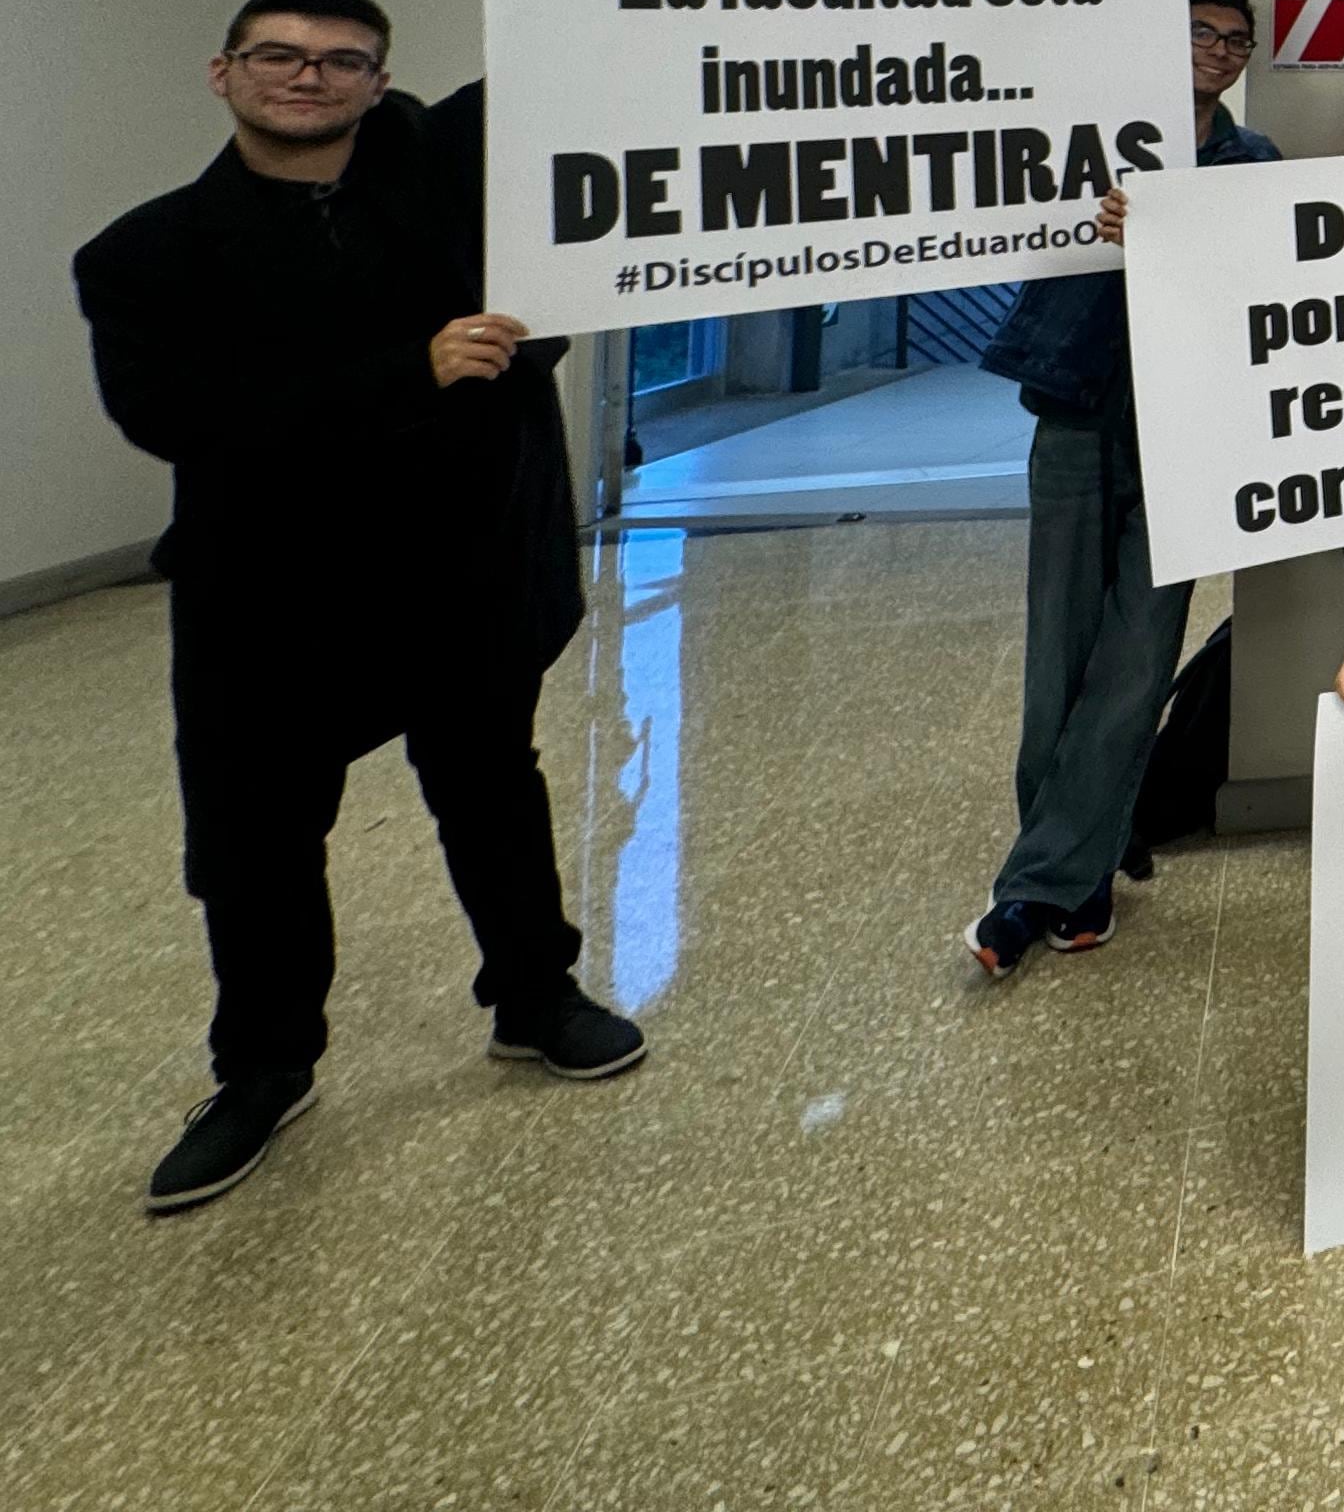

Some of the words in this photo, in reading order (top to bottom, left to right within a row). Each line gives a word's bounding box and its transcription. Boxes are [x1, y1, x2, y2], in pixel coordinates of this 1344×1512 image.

[702, 43, 1034, 114] inundada...
[552, 147, 681, 245] DE
[700, 121, 1164, 234] MENTIRAS
[615, 220, 1100, 294] #DiscípulosDeEduardoO
